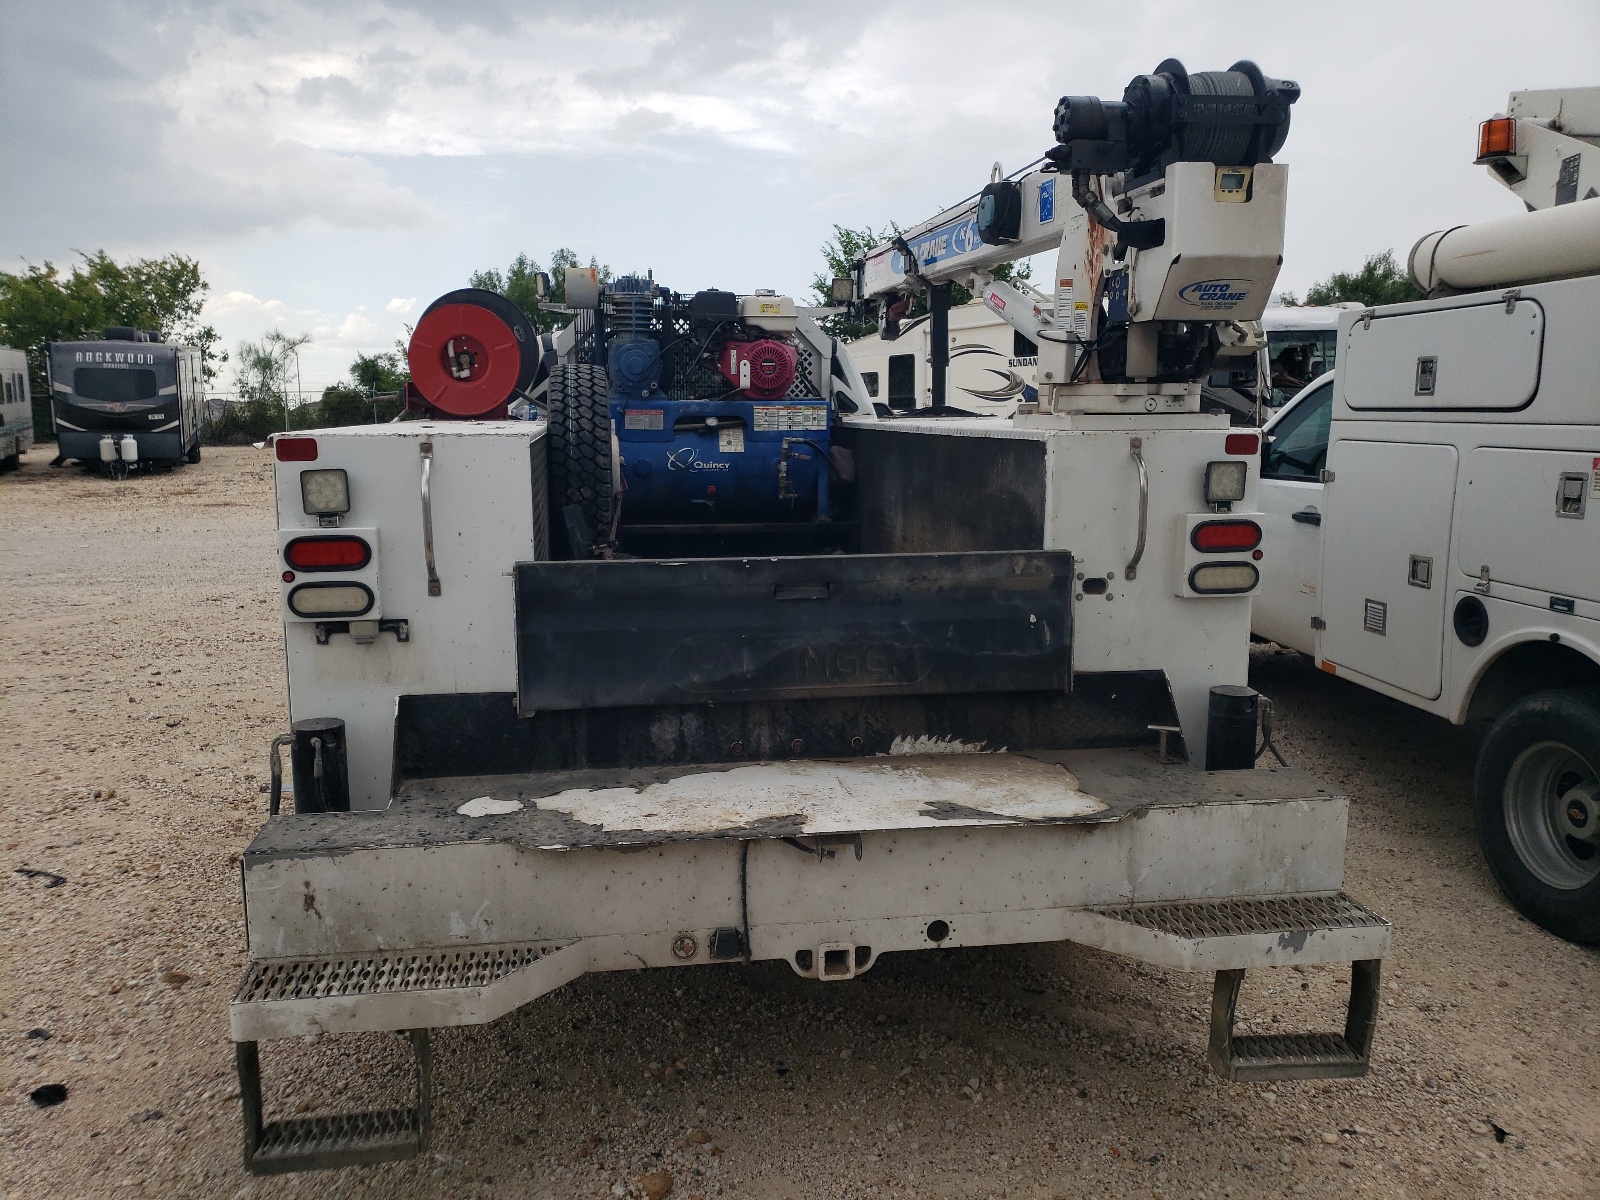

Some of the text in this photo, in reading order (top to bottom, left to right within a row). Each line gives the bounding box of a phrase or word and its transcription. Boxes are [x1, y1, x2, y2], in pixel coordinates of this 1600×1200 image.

[1190, 284, 1231, 292] AUTO
[1199, 292, 1248, 301] CRANE
[76, 351, 153, 365] ROCKWOOD
[693, 461, 730, 469] Quincy
